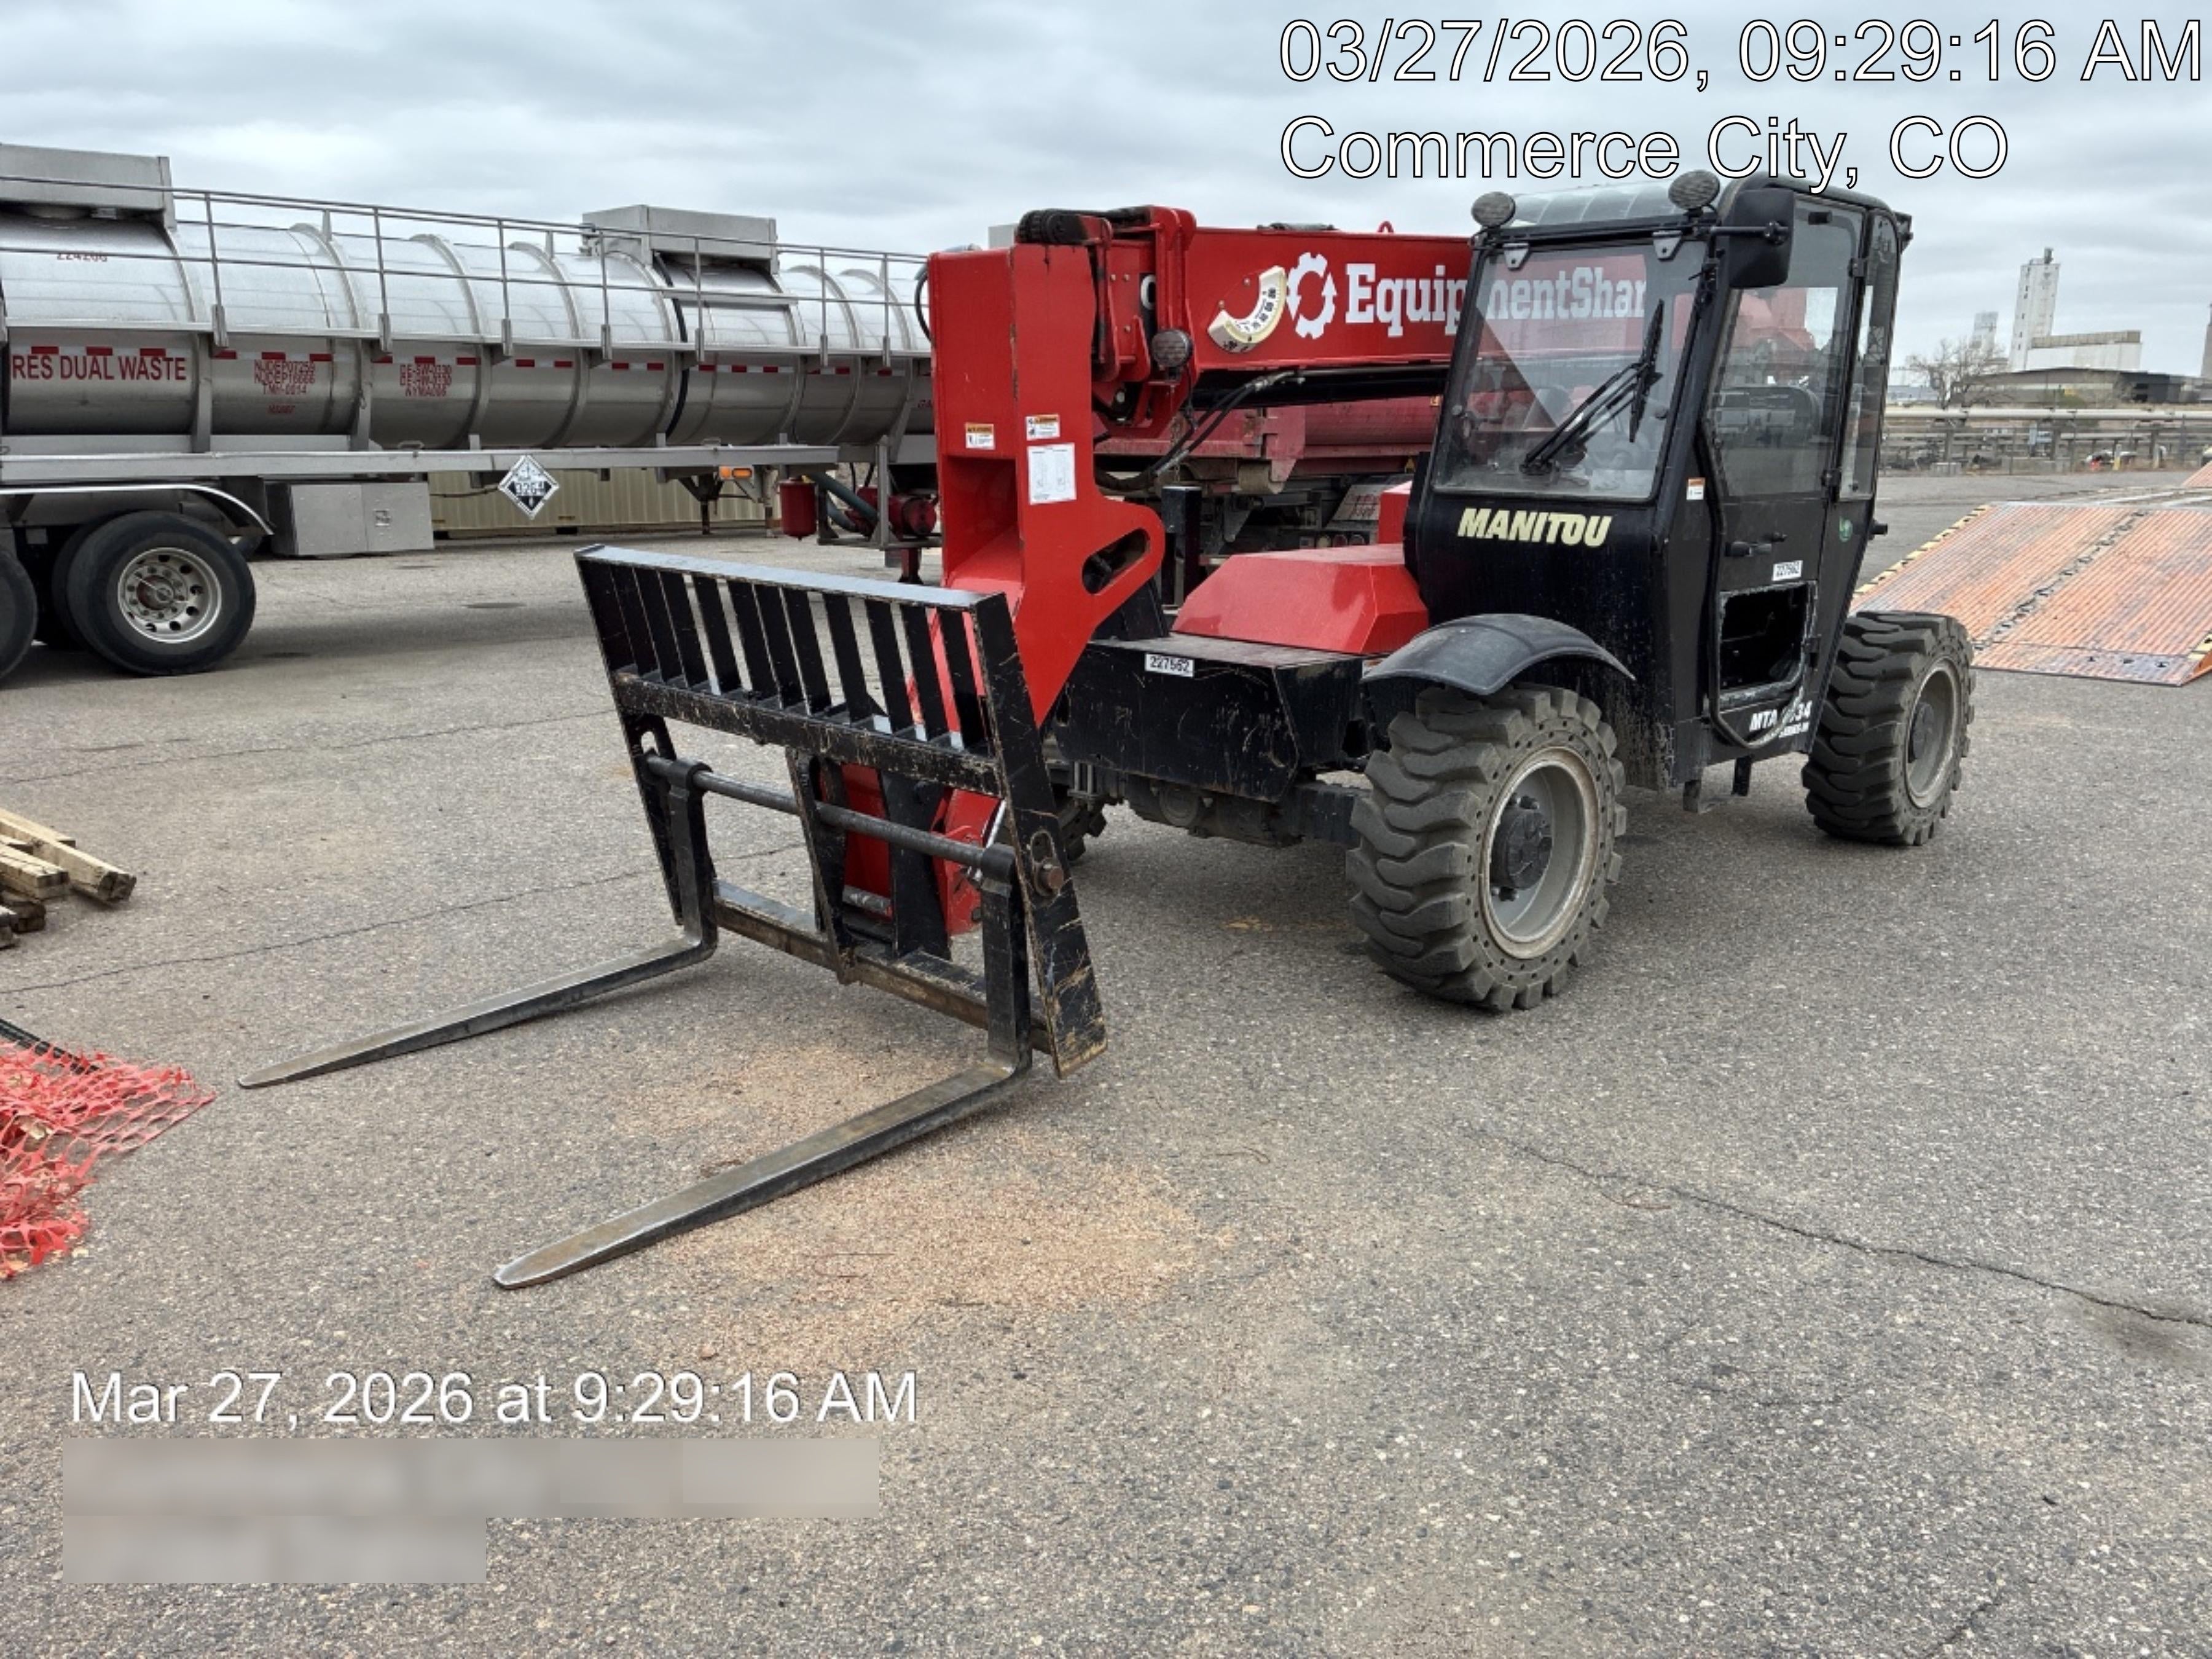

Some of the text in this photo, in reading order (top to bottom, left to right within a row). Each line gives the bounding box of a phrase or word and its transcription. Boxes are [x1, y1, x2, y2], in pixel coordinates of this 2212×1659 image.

[12, 355, 187, 380] RES DUAL WASTE
[1457, 507, 1612, 547] MANITOU
[1749, 708, 1778, 732] MTA
